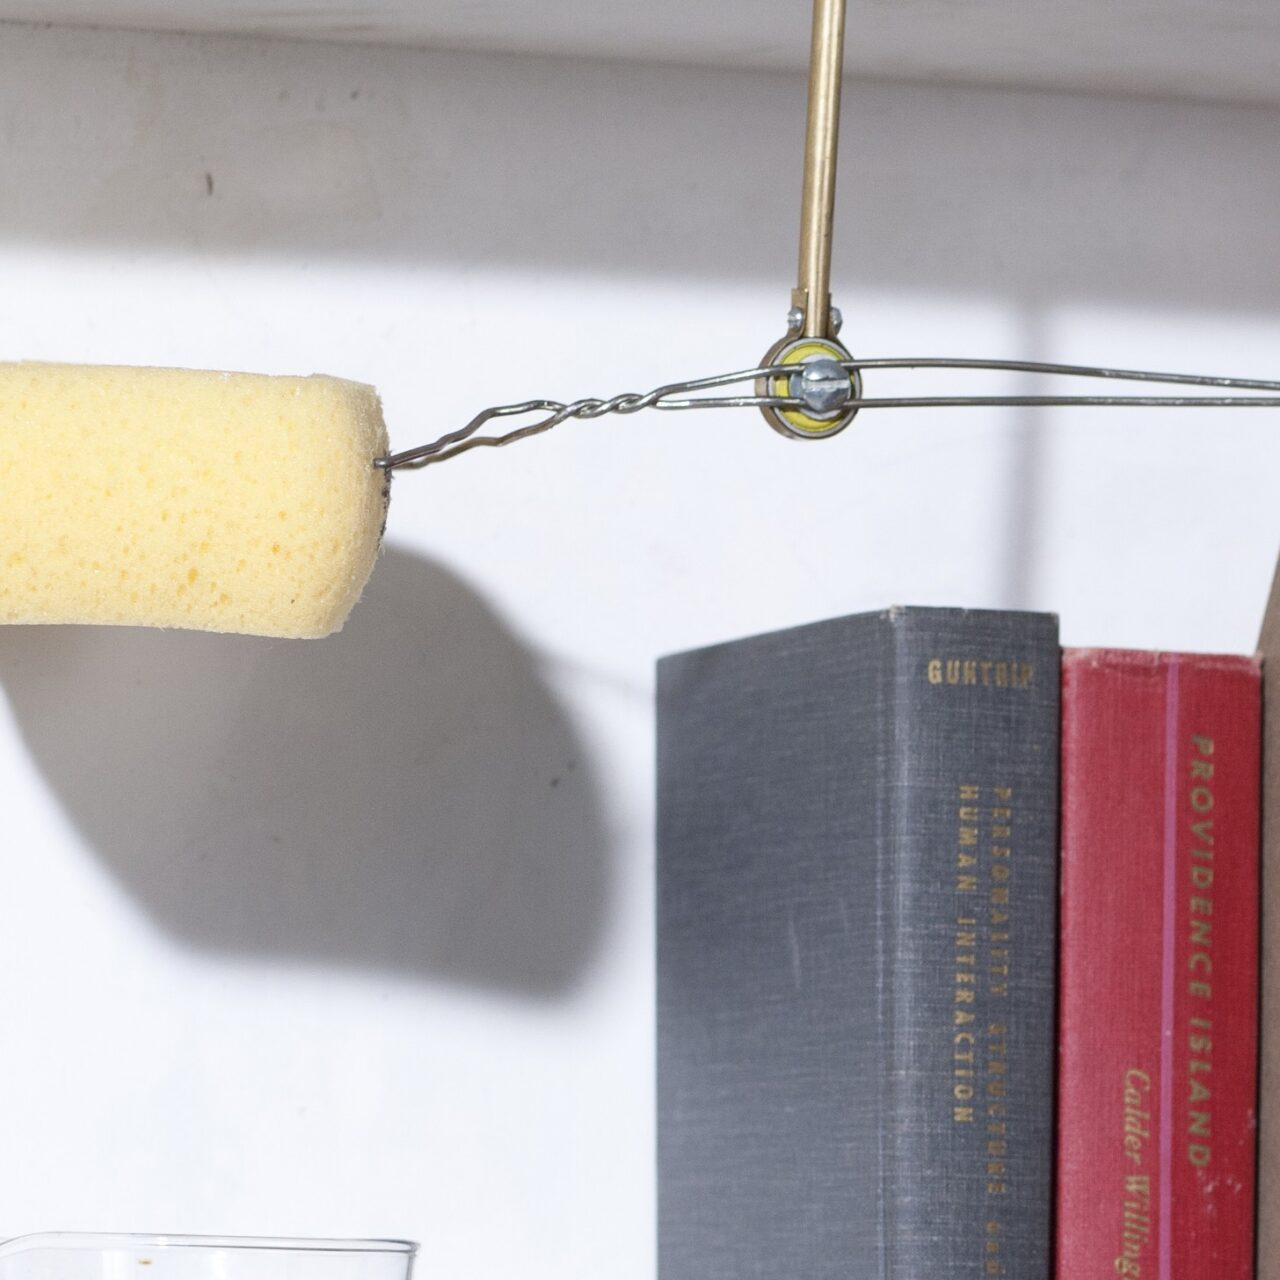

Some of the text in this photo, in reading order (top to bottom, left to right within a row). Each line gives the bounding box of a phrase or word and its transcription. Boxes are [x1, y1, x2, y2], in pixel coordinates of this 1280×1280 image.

[927, 658, 1034, 688] GUNTRIP
[954, 784, 979, 1122] HUMAN INTERACTION
[1186, 734, 1215, 1168] PROVIDENCE ISLAND
[1123, 1067, 1151, 1166] Calder
